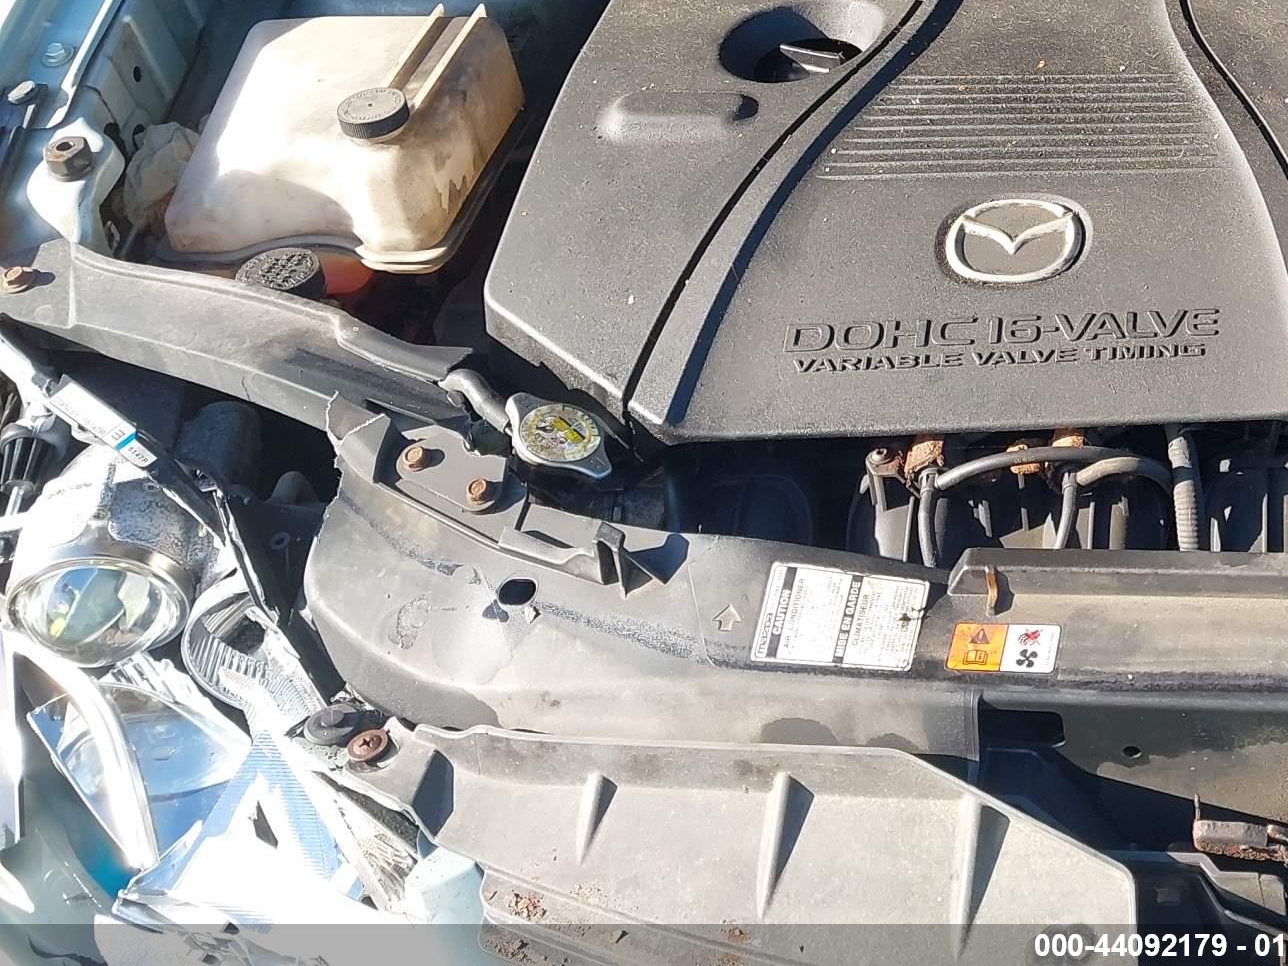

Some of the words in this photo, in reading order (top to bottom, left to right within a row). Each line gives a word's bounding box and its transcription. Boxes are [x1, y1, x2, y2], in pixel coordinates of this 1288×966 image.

[783, 317, 979, 353] DOHC
[987, 308, 1221, 345] 16-VALVE
[793, 353, 964, 373] VARIABLE
[971, 348, 1080, 367] VALVE
[1084, 343, 1206, 362] TIMING
[772, 589, 791, 635] CAUTION
[845, 581, 861, 615] GARDE
[841, 616, 854, 631] EN
[851, 594, 870, 646] CLIMATISEUR
[783, 636, 792, 649] AIR
[834, 629, 850, 658] MISE
